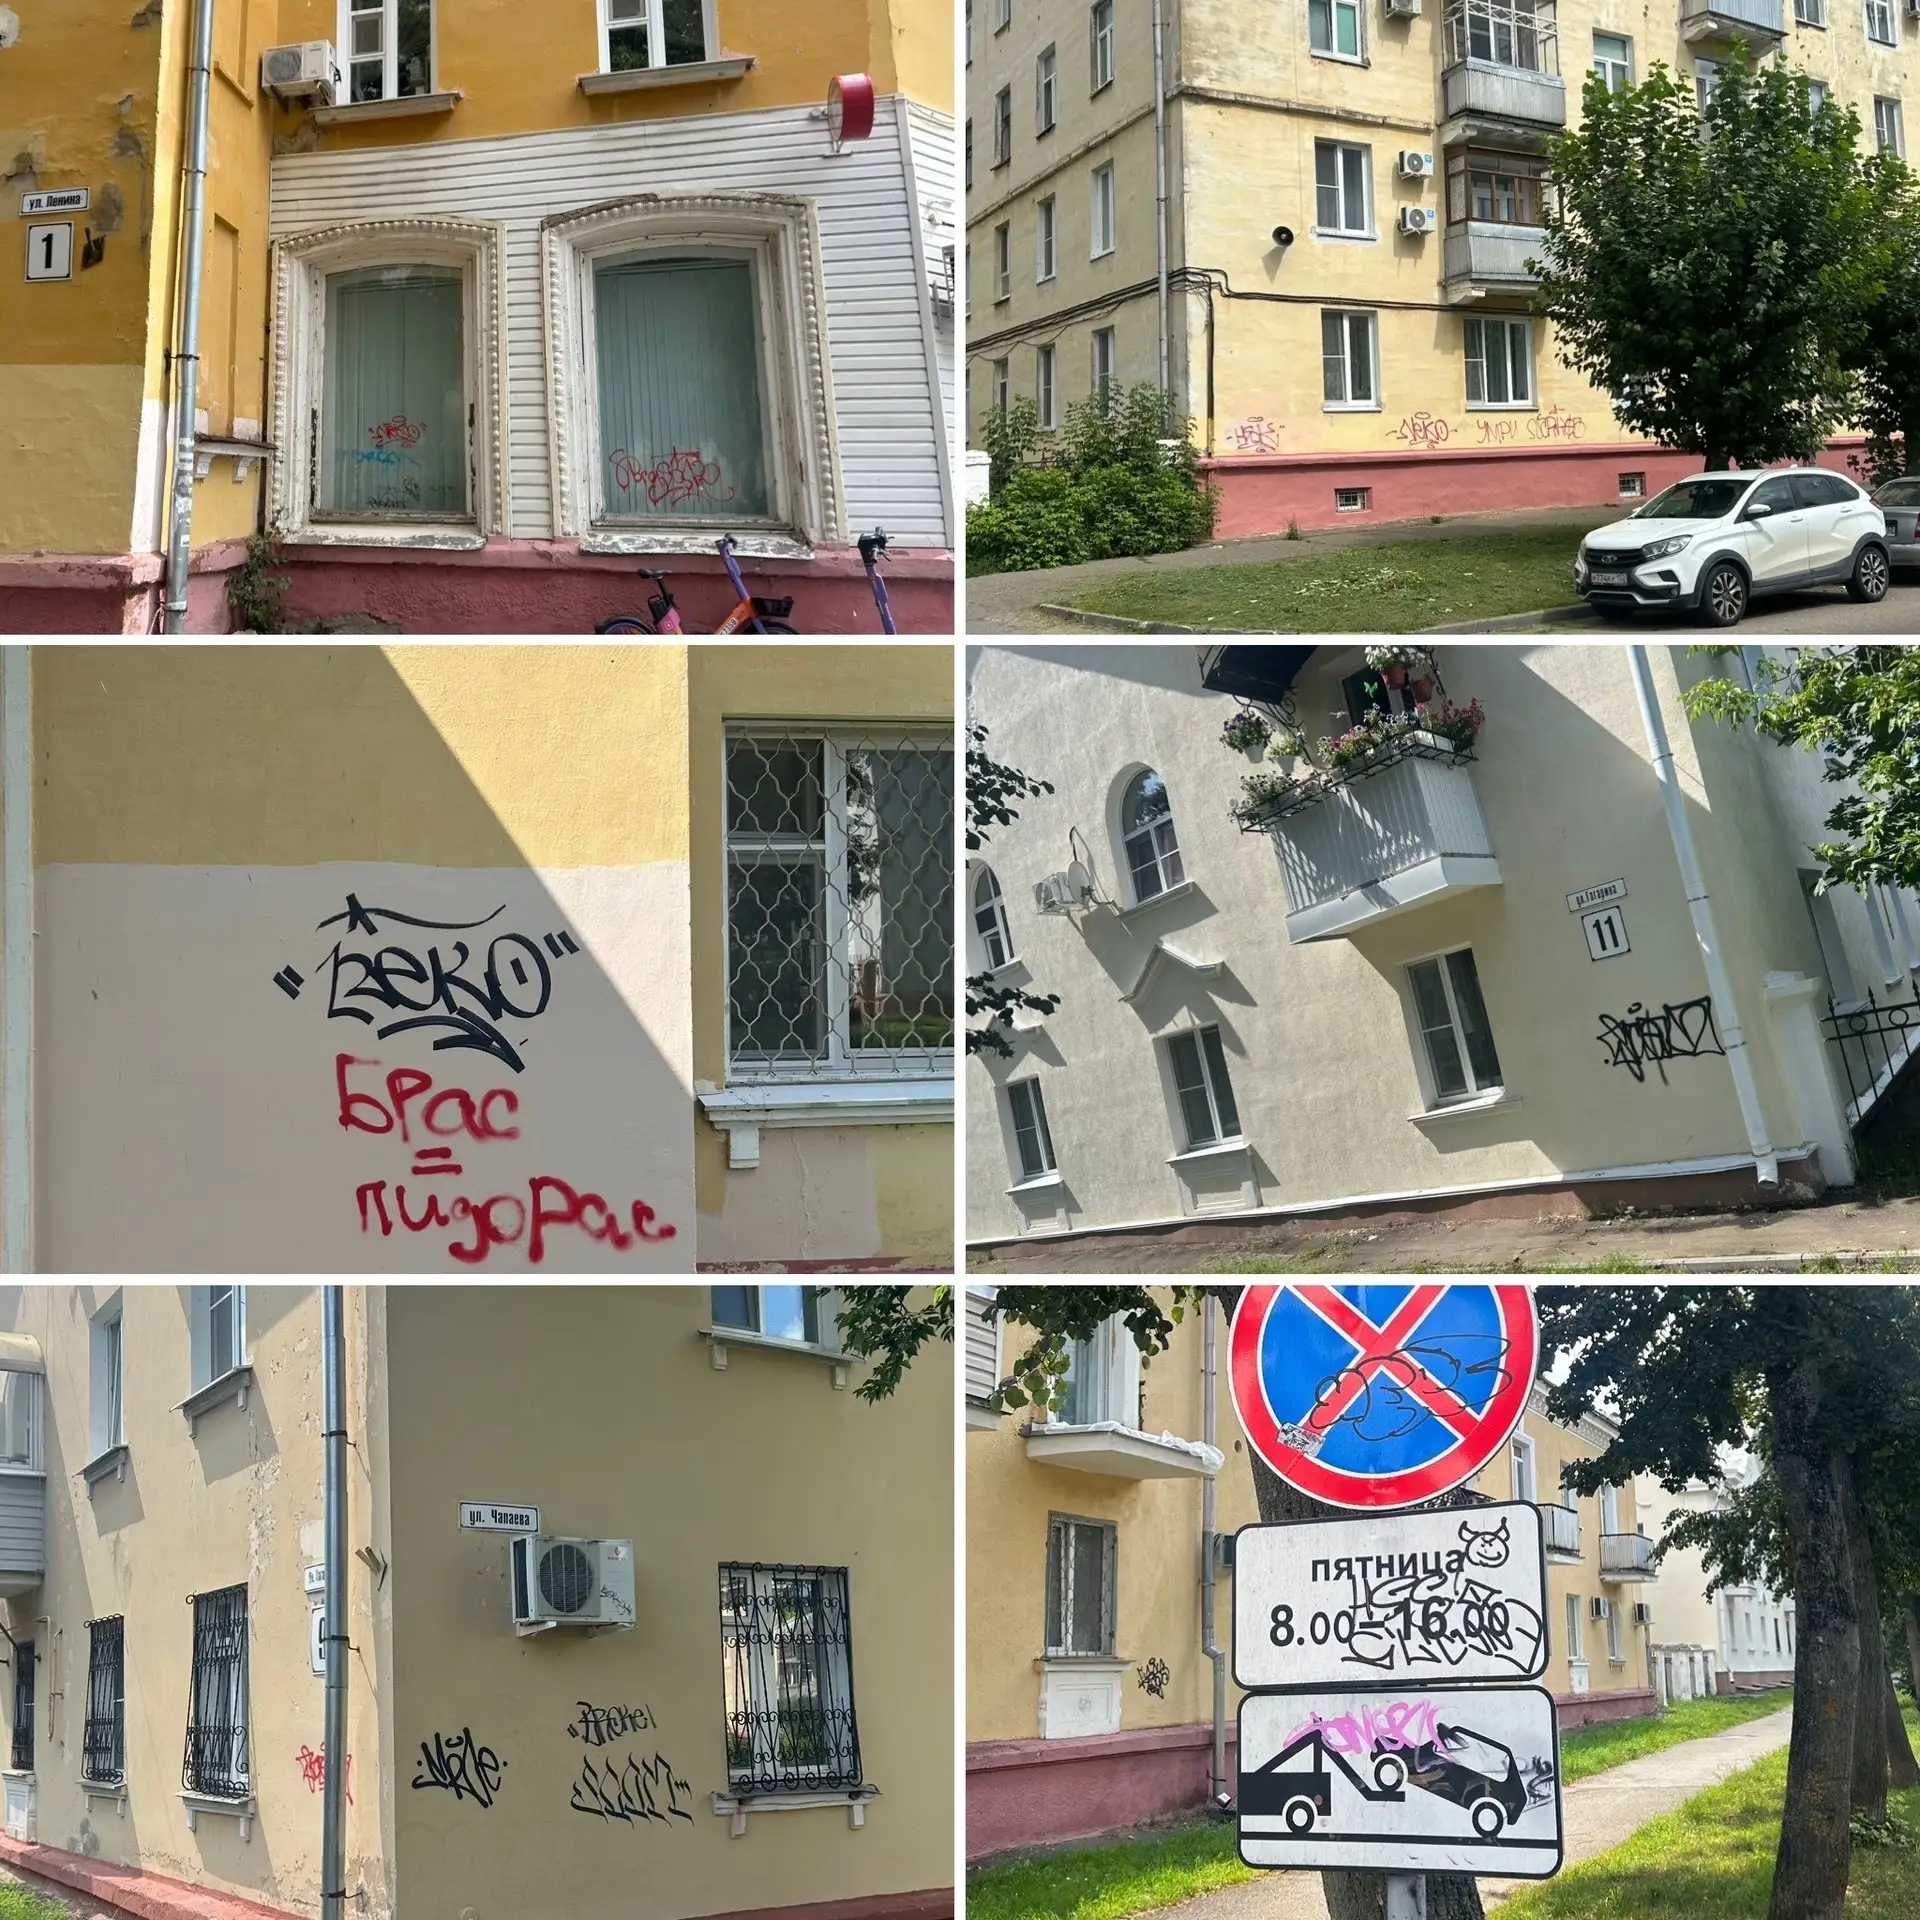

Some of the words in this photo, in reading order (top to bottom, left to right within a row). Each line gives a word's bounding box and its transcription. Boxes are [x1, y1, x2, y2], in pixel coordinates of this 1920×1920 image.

[29, 199, 43, 210] ул.
[45, 194, 81, 207] Ленина
[41, 233, 53, 269] 1
[1592, 915, 1619, 951] 11
[469, 1509, 485, 1526] ул.
[491, 1509, 530, 1526] Чапаева
[1311, 1548, 1465, 1583] пятница
